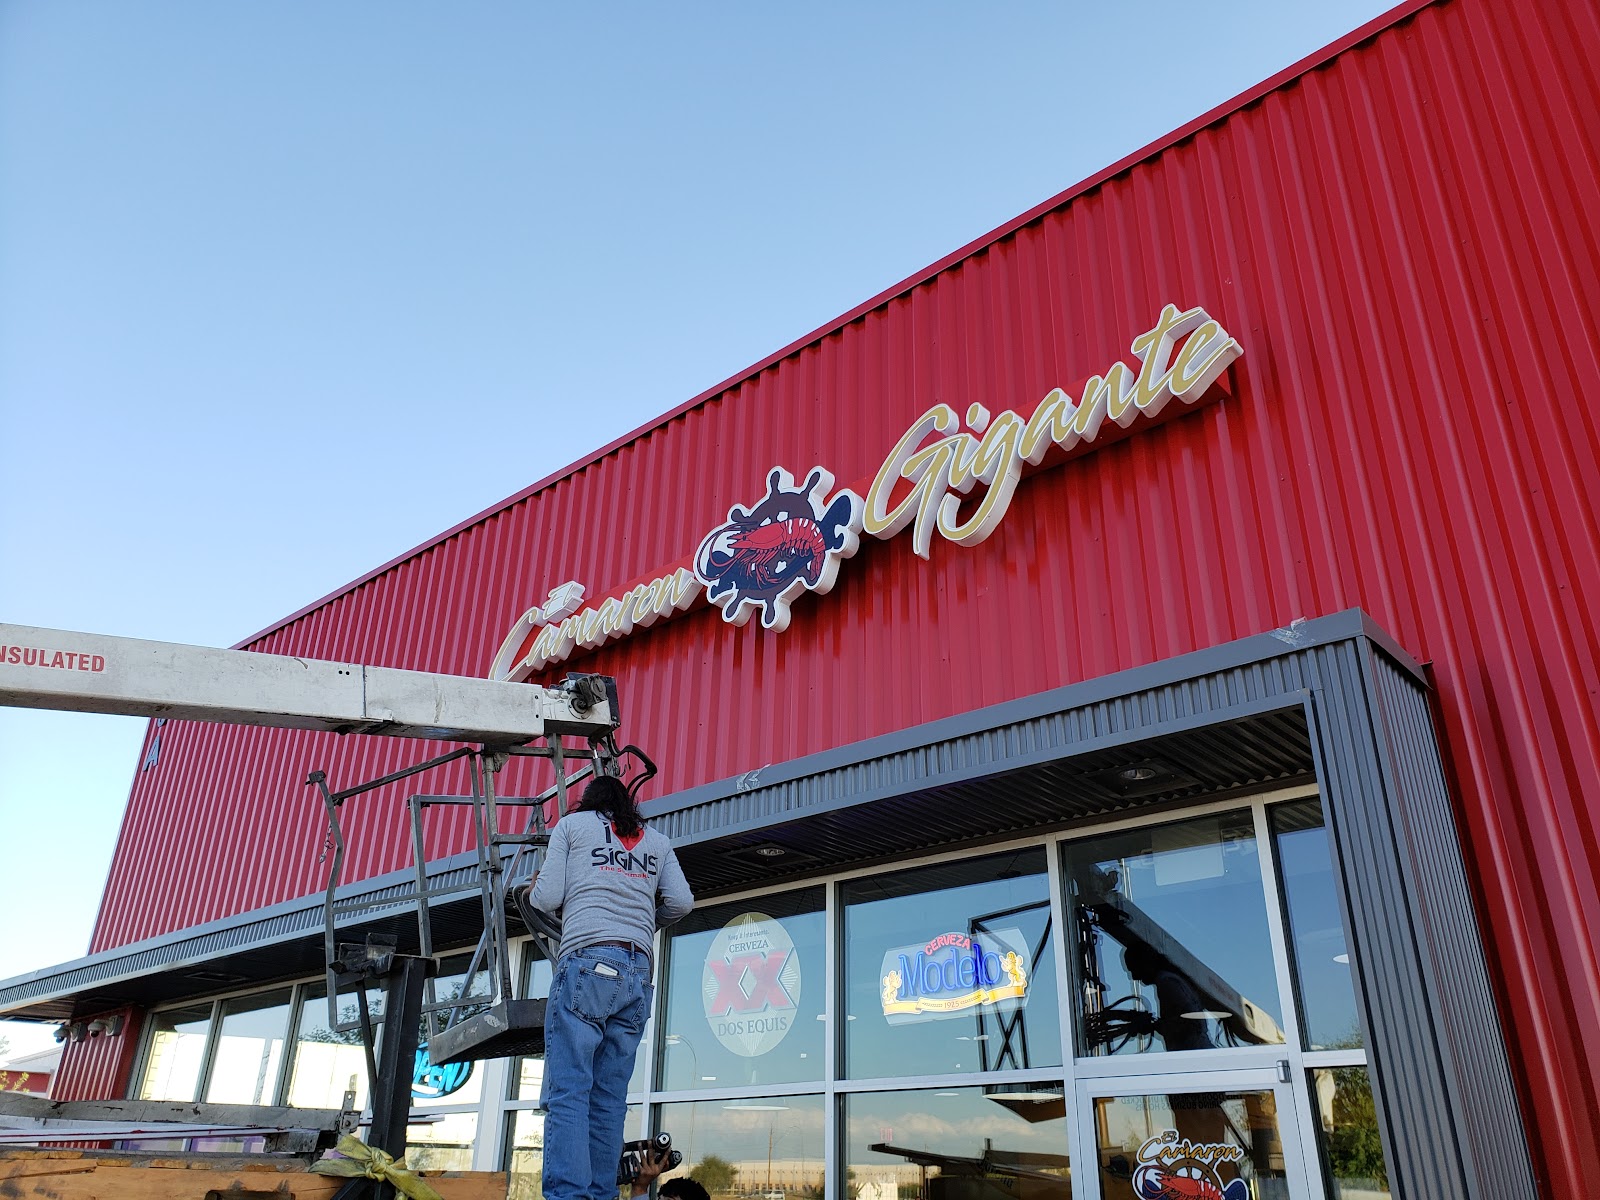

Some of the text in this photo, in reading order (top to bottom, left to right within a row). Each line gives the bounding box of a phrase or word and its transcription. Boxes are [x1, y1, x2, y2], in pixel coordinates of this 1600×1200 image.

[488, 303, 1240, 684] Camaron Gigante
[591, 847, 658, 876] SiGNS
[728, 939, 770, 953] CERVEZA
[924, 933, 971, 956] CERVEZA
[706, 949, 797, 1018] XX
[898, 943, 1001, 998] Modelo
[944, 1001, 960, 1009] 1925
[717, 1016, 788, 1037] DOS EQUIS
[1139, 1137, 1243, 1163] Camaron
